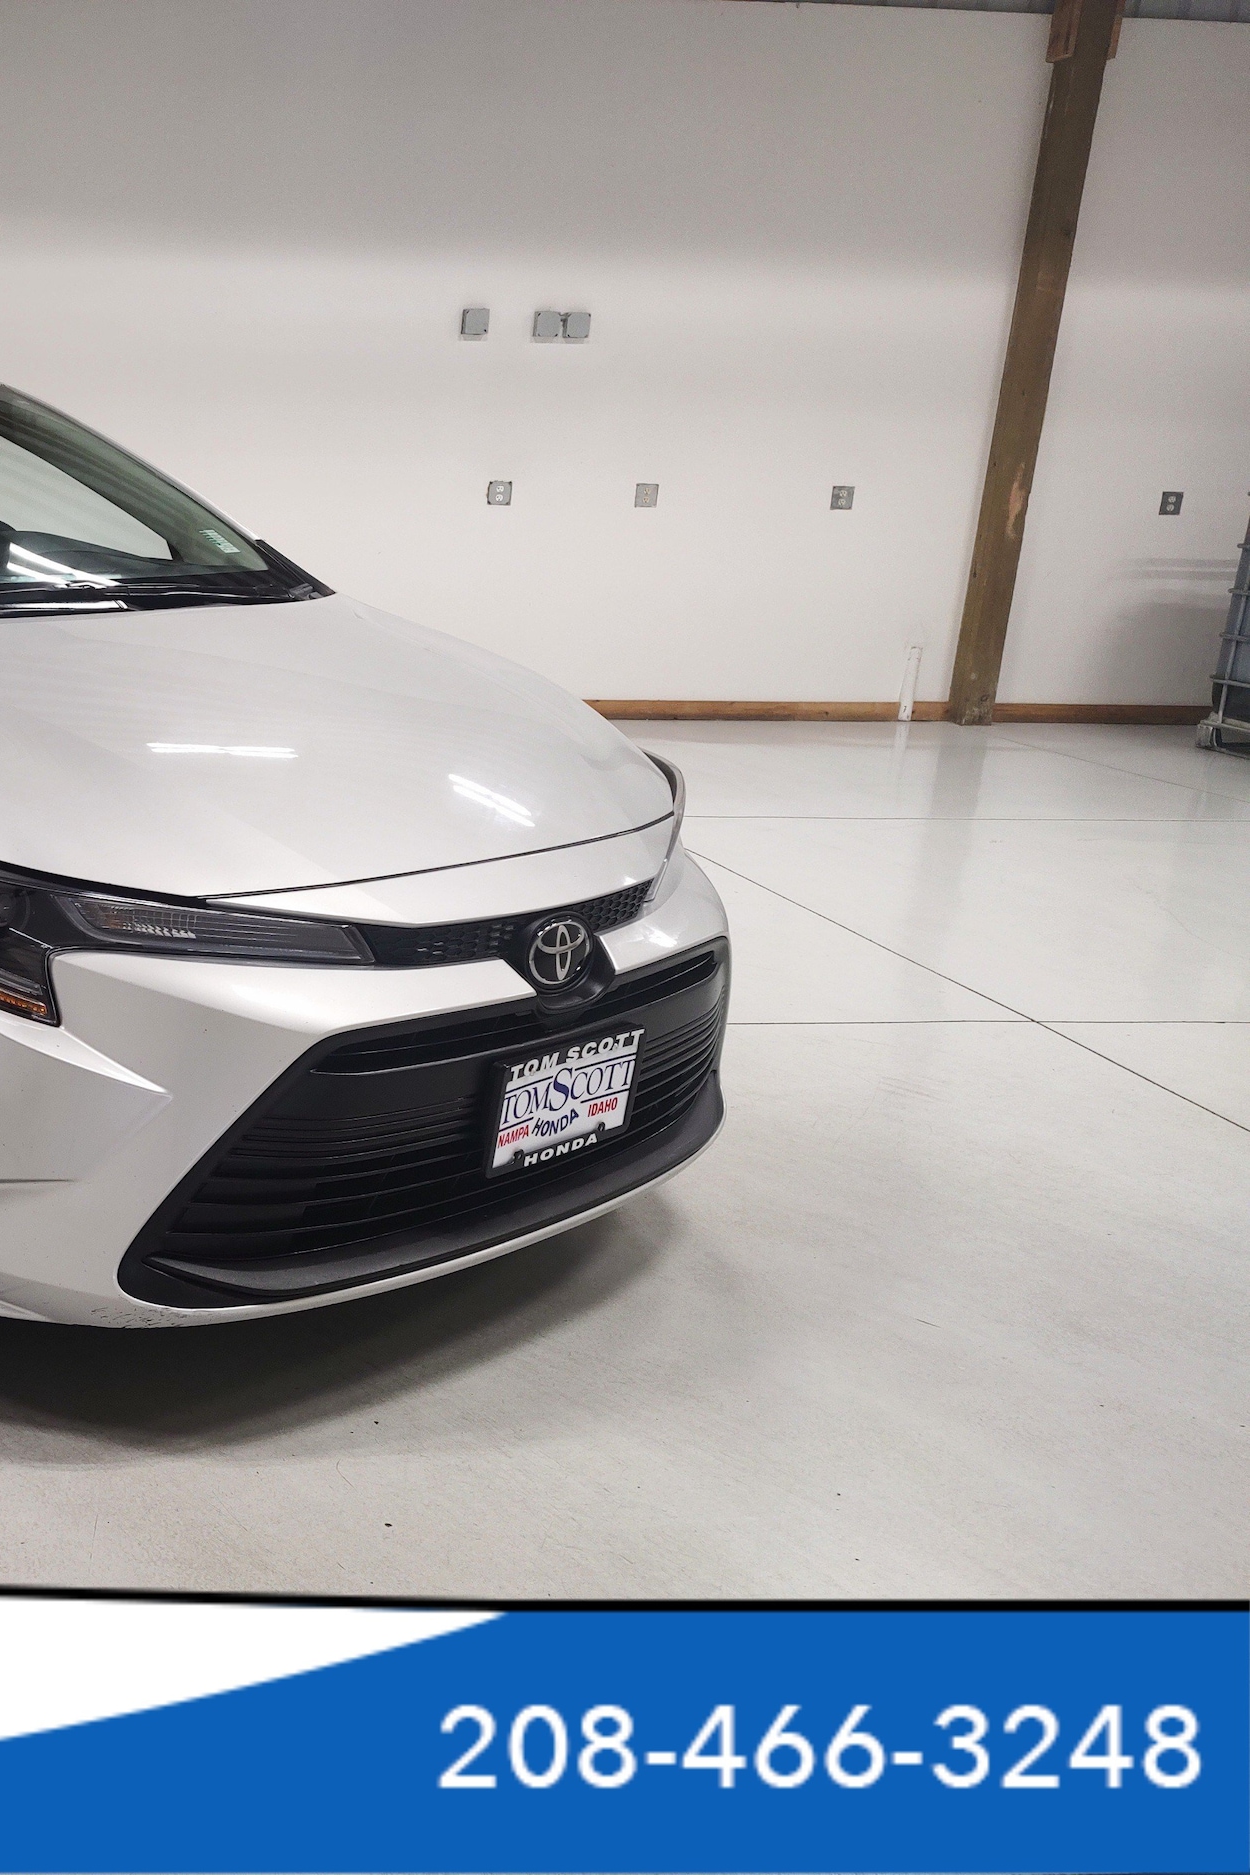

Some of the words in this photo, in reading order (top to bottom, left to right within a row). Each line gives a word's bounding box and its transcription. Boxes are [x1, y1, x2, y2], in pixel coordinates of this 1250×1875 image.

[510, 1051, 559, 1082] TOM
[565, 1029, 645, 1063] SCOTT
[497, 1124, 530, 1149] NAMPA
[532, 1107, 580, 1137] HONDA
[587, 1096, 618, 1118] IDAHO
[523, 1133, 598, 1167] HONDA
